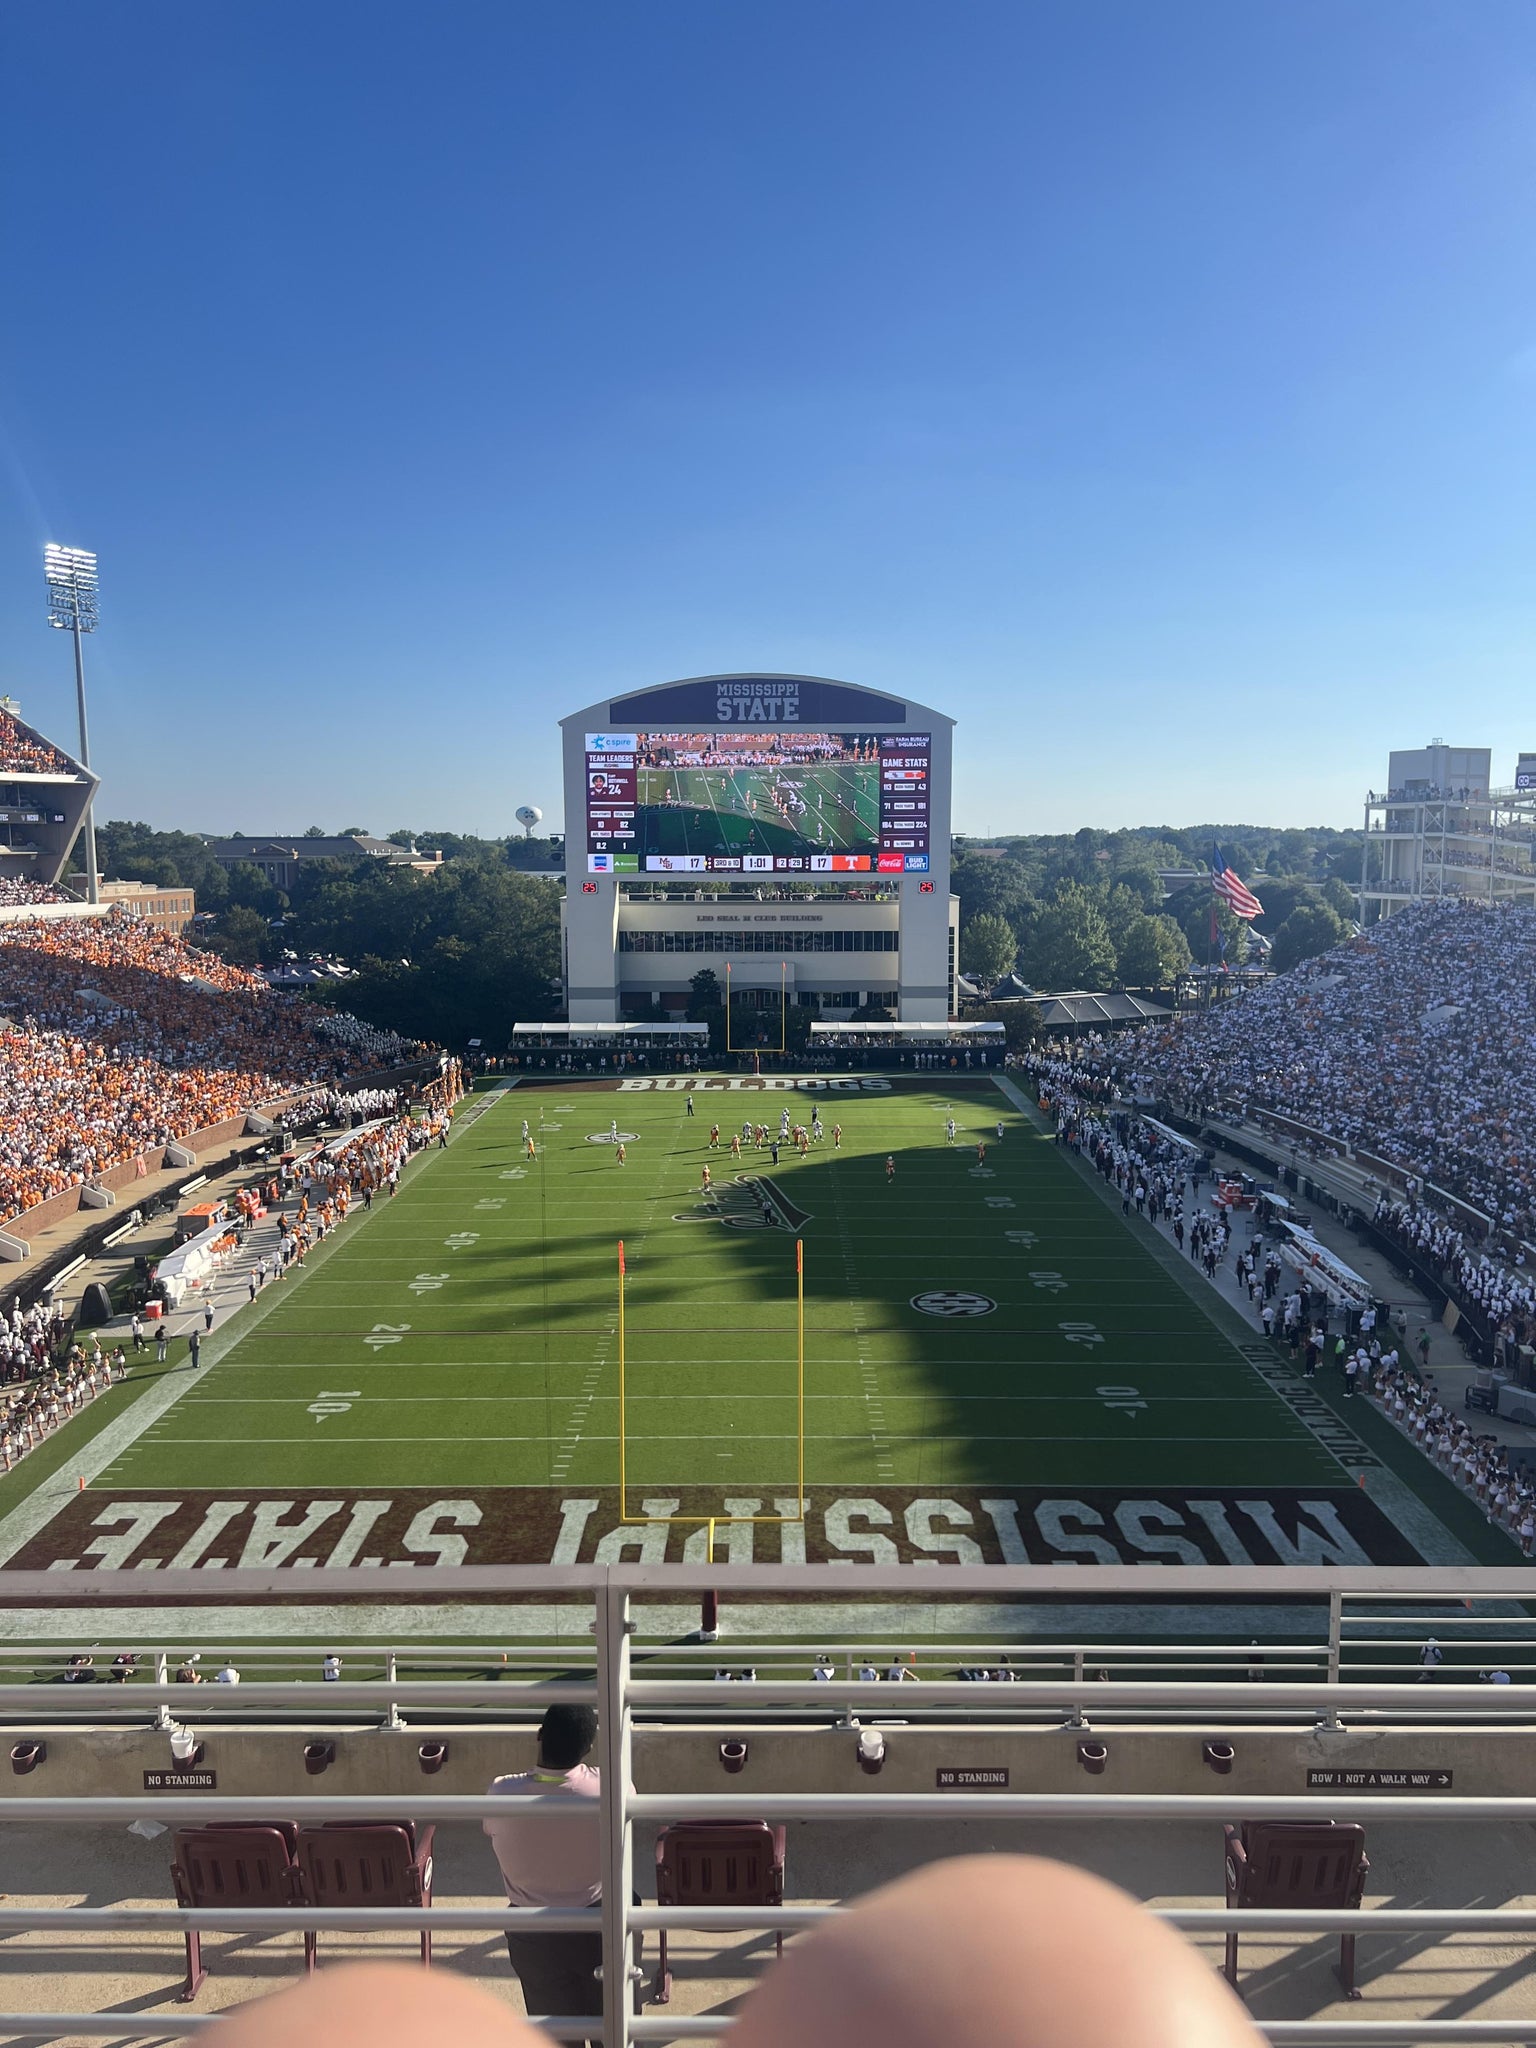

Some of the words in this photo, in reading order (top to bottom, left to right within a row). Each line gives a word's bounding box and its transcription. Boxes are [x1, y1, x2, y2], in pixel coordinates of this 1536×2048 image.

[717, 684, 799, 696] MISSISSIPPI
[717, 697, 799, 721] STATE
[883, 758, 903, 767] GAME
[905, 758, 927, 767] STATS
[608, 785, 621, 795] 24
[623, 842, 627, 850] 1
[690, 858, 700, 868] 17
[749, 858, 766, 868] 1:01
[817, 858, 826, 868] 17
[845, 856, 858, 869] T
[583, 883, 595, 892] 25
[921, 882, 932, 892] 25
[616, 1078, 892, 1092] BULLDOGS
[473, 1197, 507, 1210] 50
[984, 1196, 1016, 1208] 50
[443, 1231, 480, 1246] 40
[1004, 1230, 1040, 1244] 40
[408, 1273, 450, 1290] 30
[1028, 1271, 1069, 1288] 30
[916, 1292, 991, 1316] SEC
[362, 1323, 412, 1344] 20
[1057, 1322, 1106, 1343] 20
[1237, 1344, 1299, 1380] CLUB
[306, 1390, 362, 1414] 10
[1095, 1386, 1149, 1409] 10
[1277, 1387, 1385, 1468] BULLDOG
[47, 1499, 482, 1569] STATE
[550, 1498, 1373, 1567] MISSISSIPPI
[148, 1775, 161, 1785] NO
[165, 1775, 212, 1785] STANDING
[941, 1773, 954, 1783] NO
[958, 1773, 1006, 1783] STANDING
[1311, 1773, 1333, 1783] ROW
[1337, 1774, 1341, 1783] 1
[1346, 1774, 1366, 1783] NOT
[1368, 1774, 1376, 1784] A
[1380, 1774, 1407, 1784] WALK
[1411, 1774, 1431, 1784] WAY
